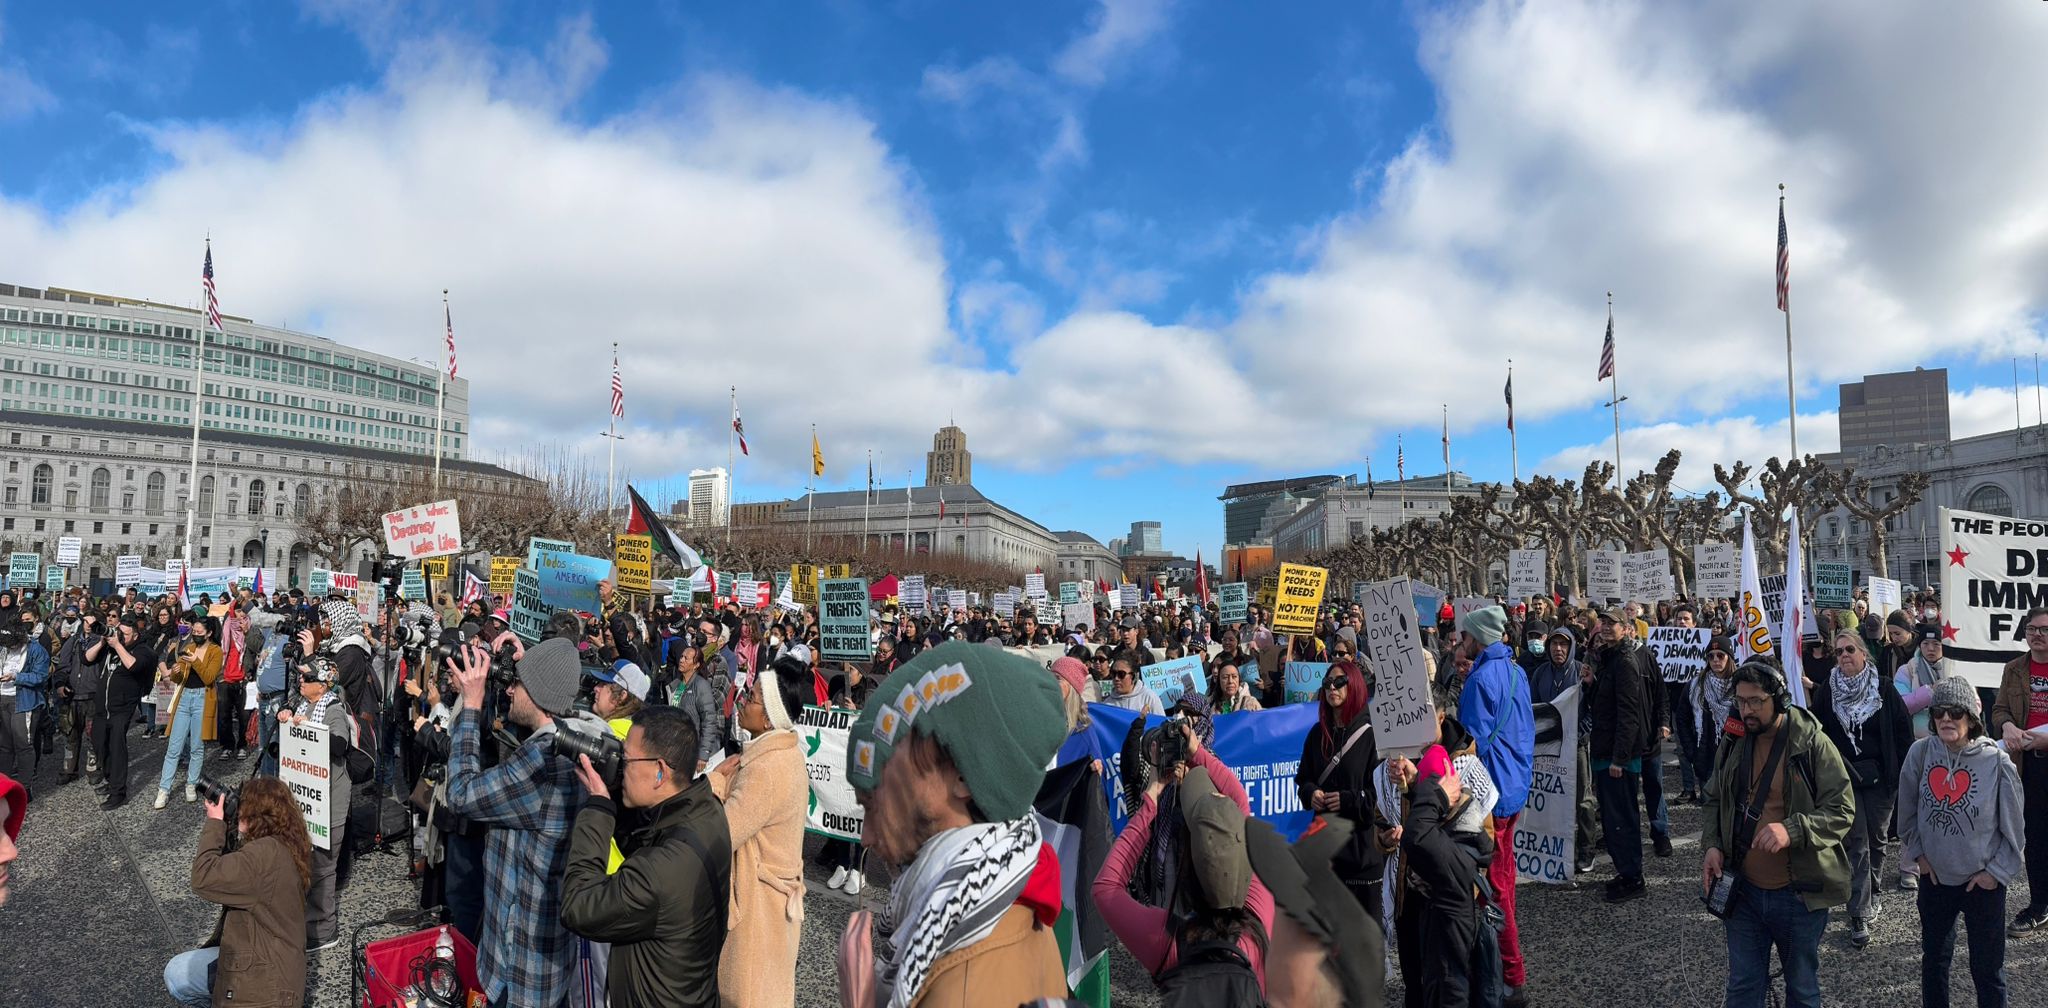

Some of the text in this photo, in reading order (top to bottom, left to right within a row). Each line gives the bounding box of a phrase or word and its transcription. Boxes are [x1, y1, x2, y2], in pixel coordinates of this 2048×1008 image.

[386, 512, 404, 524] This
[411, 509, 418, 518] is
[391, 521, 435, 540] Democracy
[1952, 517, 1993, 535] THE
[411, 533, 457, 555] Looks Like
[542, 553, 566, 568] Todos
[618, 552, 648, 564] PUEBLO,
[630, 569, 648, 577] PARA
[798, 565, 811, 575] END
[830, 566, 842, 576] END
[1285, 568, 1308, 576] MONEY
[825, 582, 860, 592] IMMIGRANT
[1284, 576, 1320, 587] PEOPLE'S
[1817, 576, 1848, 585] POWER
[517, 583, 537, 597] SHOULD
[822, 592, 865, 601] AND WORKERS
[1285, 586, 1315, 597] NEEDS
[1223, 594, 1243, 603] RIGHTS
[1762, 594, 1781, 611] OFF
[826, 602, 862, 617] RIGHTS
[1278, 604, 1317, 614] NOT THE
[513, 610, 530, 627] NOT
[822, 625, 867, 634] ONE STRUGGLE
[1650, 628, 1702, 644] AMERICA
[823, 637, 867, 650] ONE FIGHT
[1143, 667, 1162, 678] WHEN
[1288, 663, 1322, 683] NO a
[1150, 678, 1168, 690] FIGHT
[289, 726, 319, 742] ISRAEL
[281, 757, 328, 779] APARTHEID
[1243, 760, 1300, 780] RIGHTS, WORKE
[1514, 830, 1564, 857] GRAM
[1513, 852, 1568, 880] CO CA
